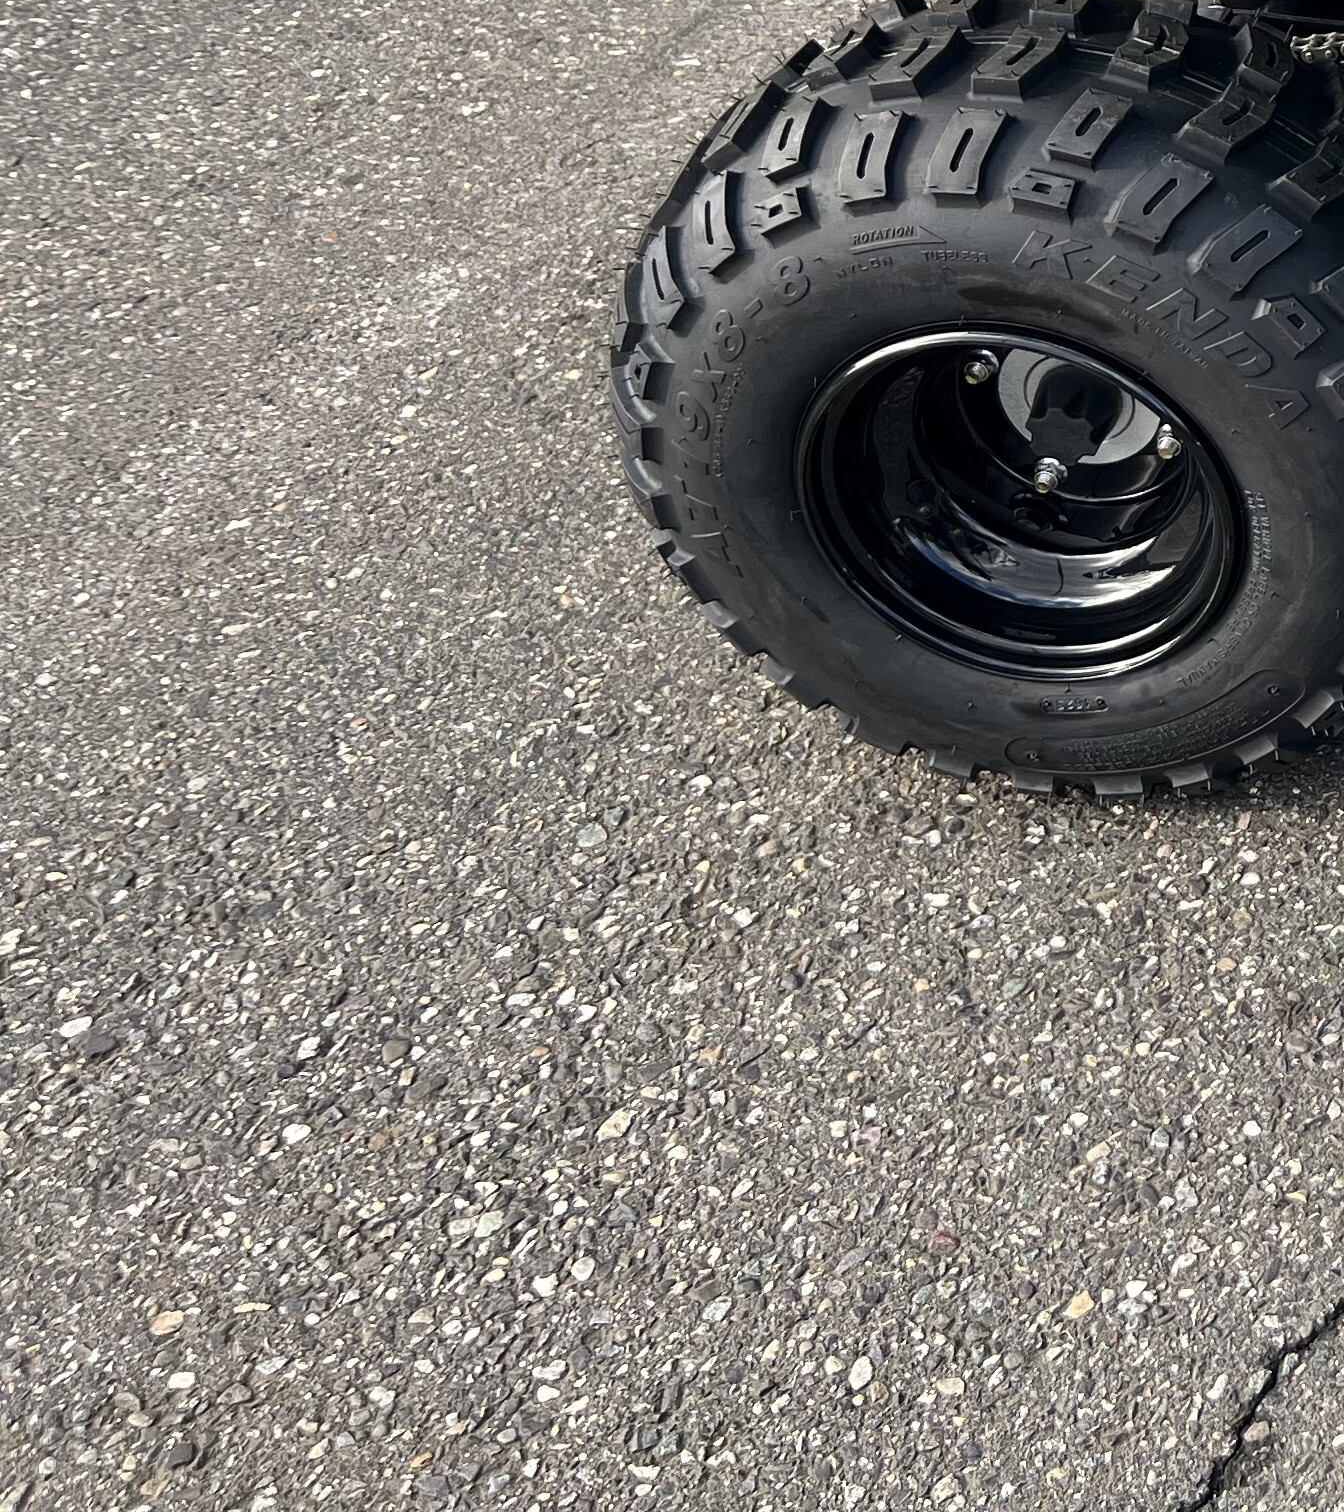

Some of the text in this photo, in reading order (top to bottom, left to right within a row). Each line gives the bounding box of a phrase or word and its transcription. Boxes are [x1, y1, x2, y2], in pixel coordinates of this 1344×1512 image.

[852, 225, 914, 246] ROTATION
[921, 250, 988, 264] TUBELESS
[1012, 229, 1309, 430] KENDA
